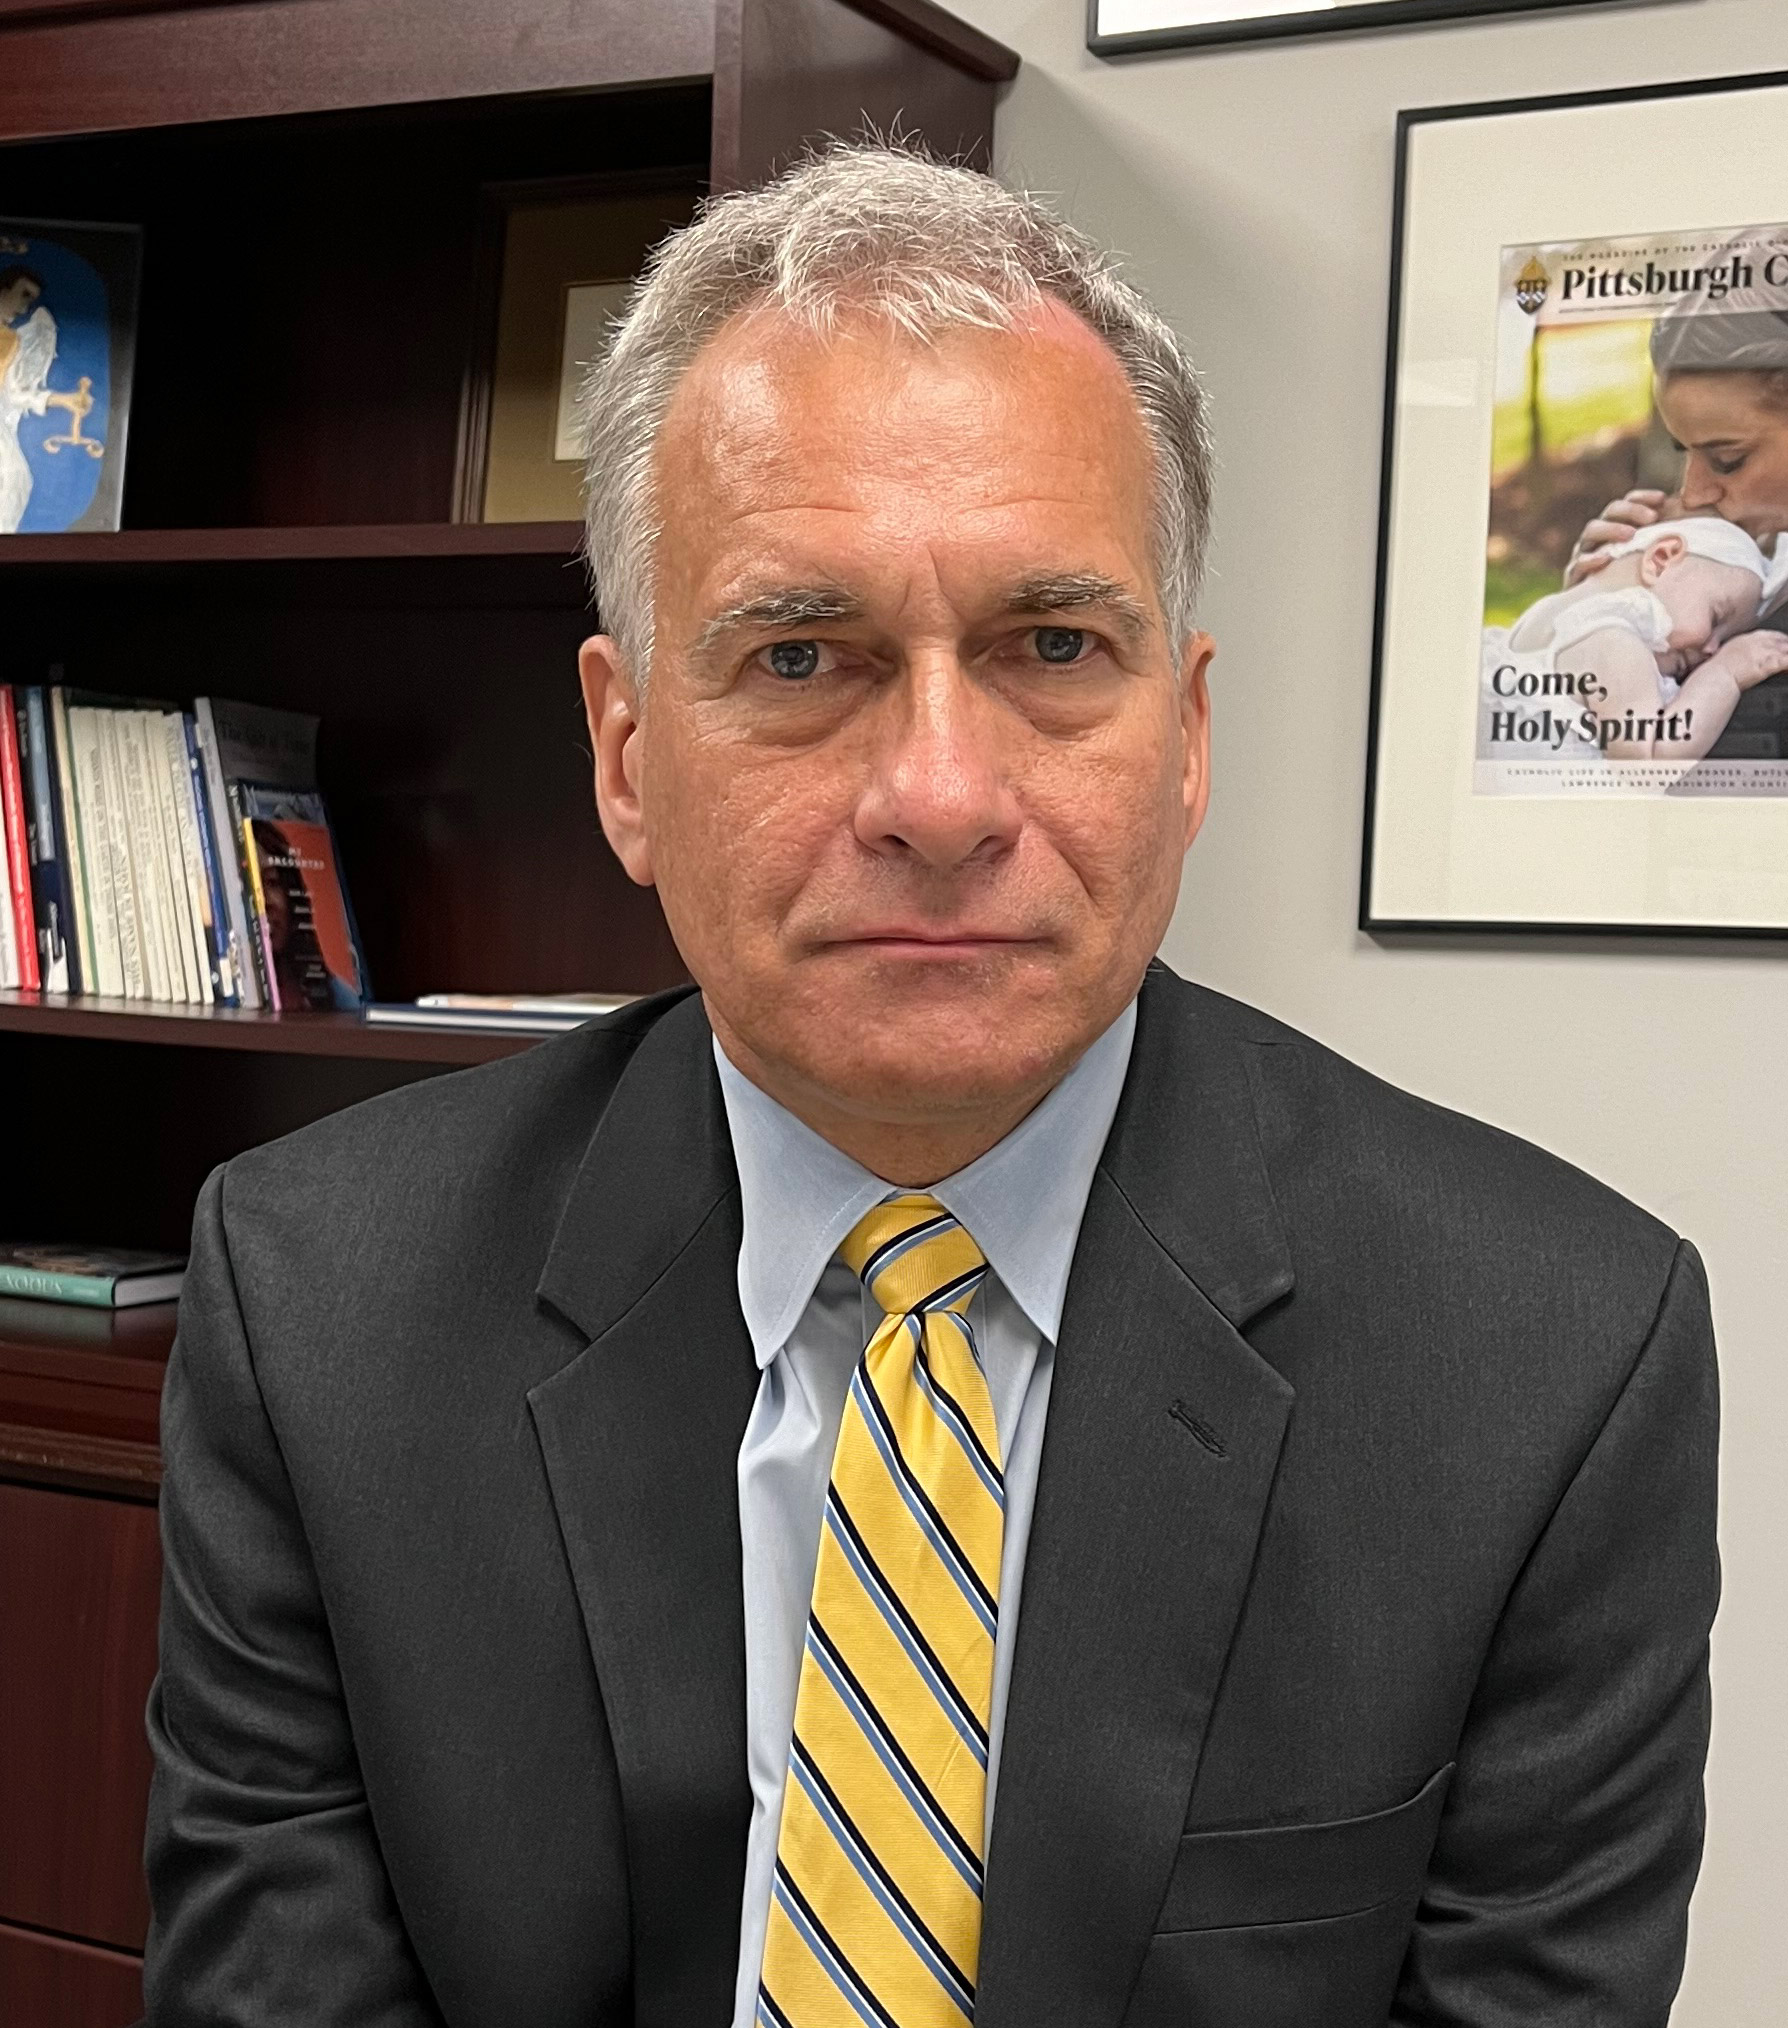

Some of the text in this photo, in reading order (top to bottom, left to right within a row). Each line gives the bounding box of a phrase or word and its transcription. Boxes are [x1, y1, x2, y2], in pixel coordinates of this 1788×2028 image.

[1561, 253, 1788, 301] Pittsburgh C
[1491, 664, 1609, 702] Come,
[1489, 708, 1694, 751] Holy Spirit!
